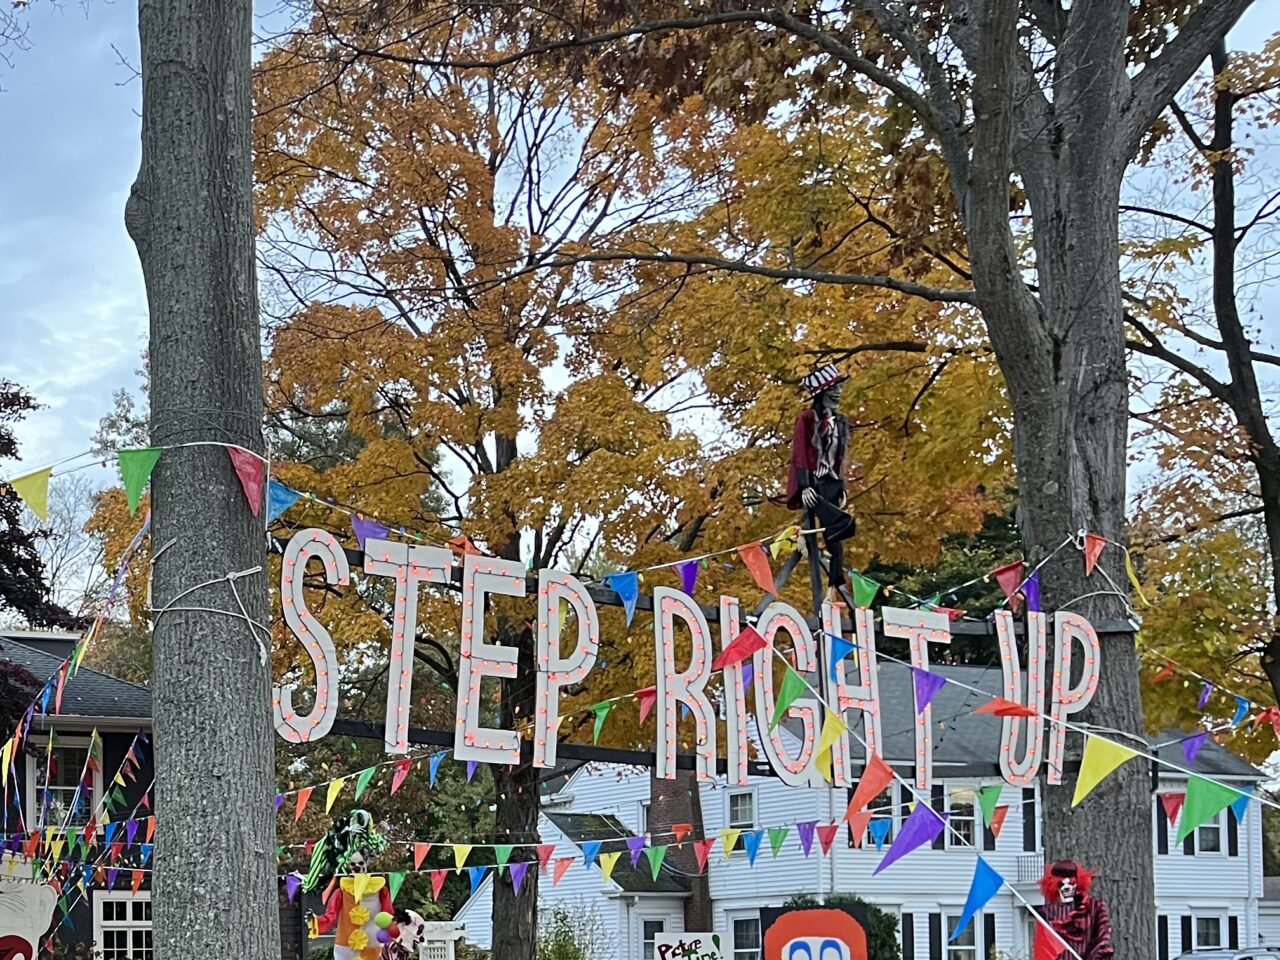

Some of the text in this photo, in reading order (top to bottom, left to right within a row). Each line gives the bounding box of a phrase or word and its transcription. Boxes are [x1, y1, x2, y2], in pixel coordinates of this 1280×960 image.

[272, 528, 1101, 790] STEP RIGHT UP
